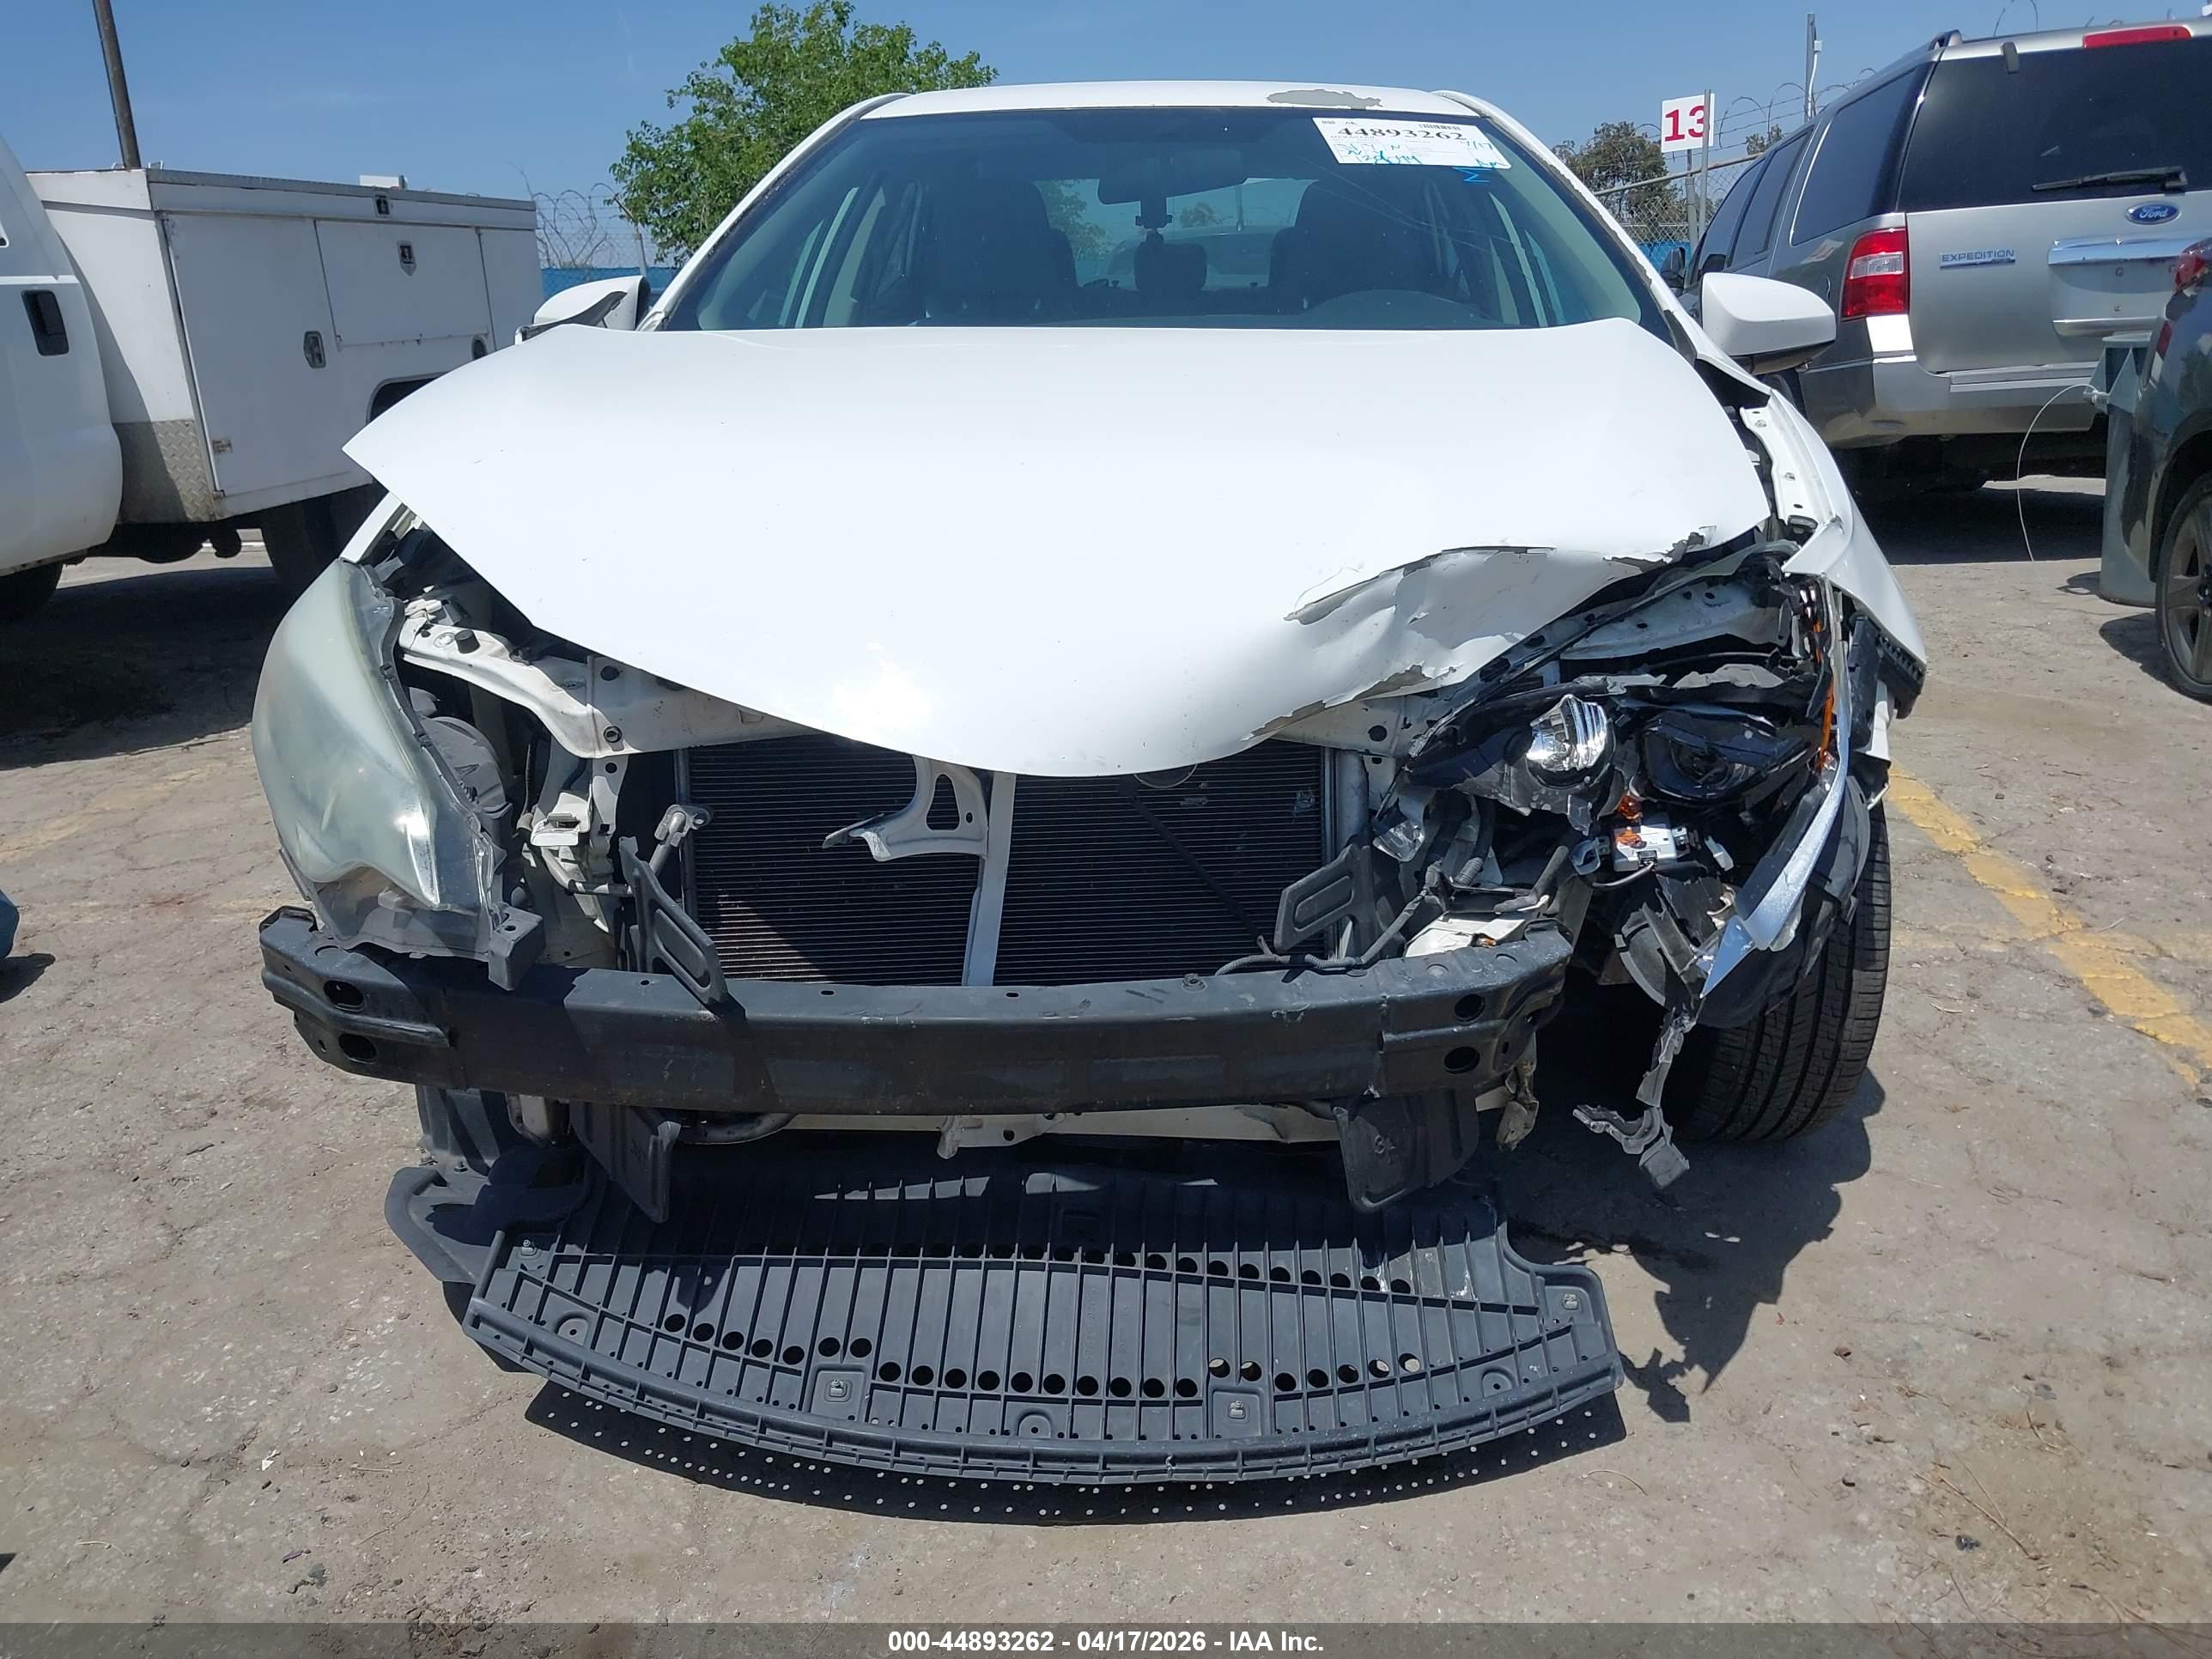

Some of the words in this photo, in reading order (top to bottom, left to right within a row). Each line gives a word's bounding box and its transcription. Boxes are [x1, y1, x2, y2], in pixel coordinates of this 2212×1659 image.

[1664, 105, 1705, 142] 13
[1337, 127, 1468, 141] 44893262
[2139, 206, 2169, 219] Ford
[1942, 249, 2014, 262] EXPEDITION
